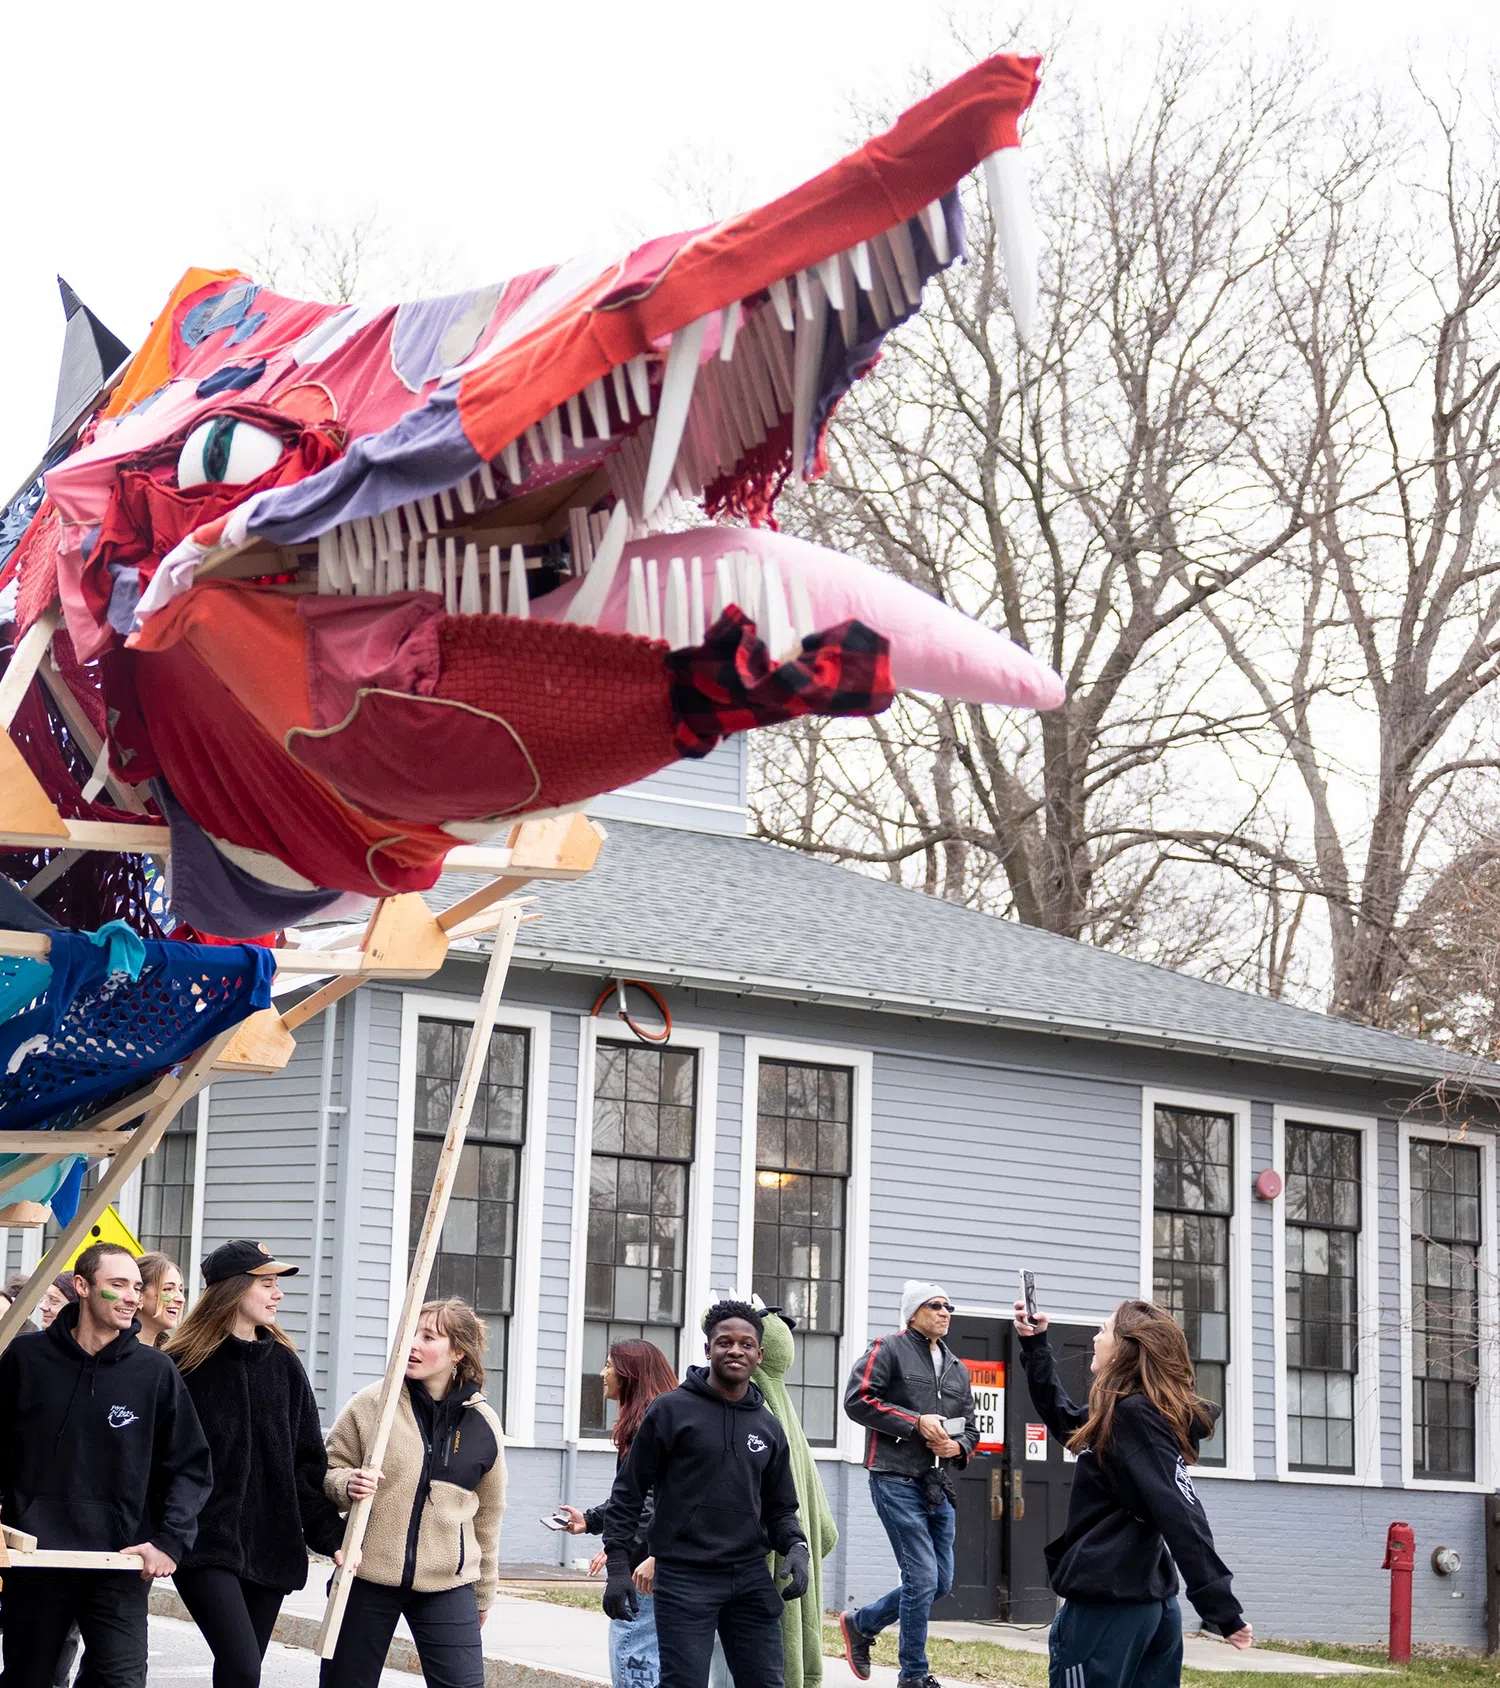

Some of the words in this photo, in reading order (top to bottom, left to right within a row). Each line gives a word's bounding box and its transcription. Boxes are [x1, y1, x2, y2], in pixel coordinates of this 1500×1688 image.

[970, 1370, 996, 1384] UTION
[974, 1392, 998, 1411] NOT
[974, 1415, 994, 1433] TER
